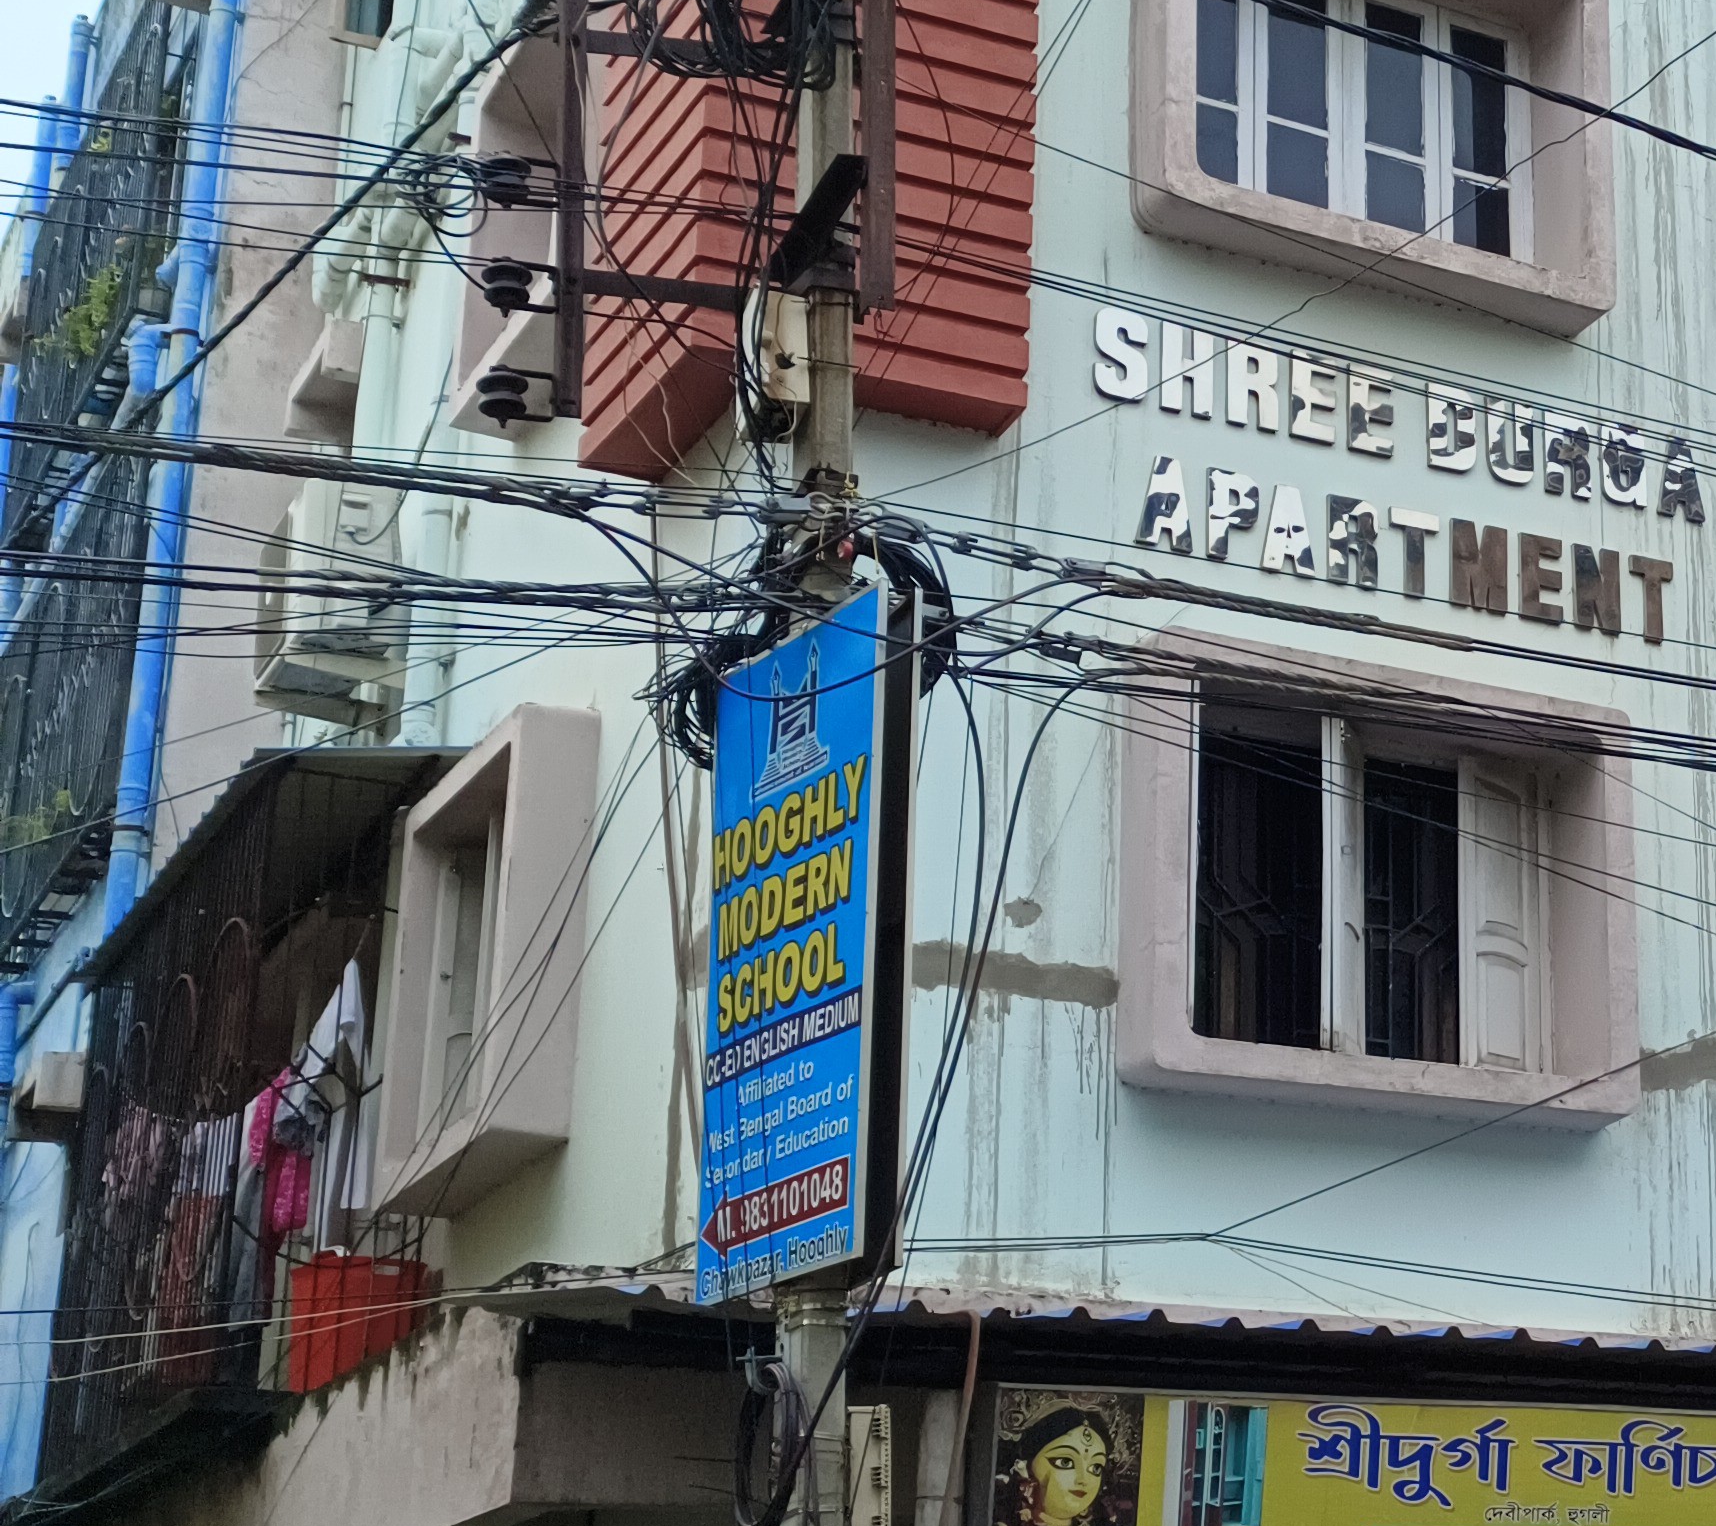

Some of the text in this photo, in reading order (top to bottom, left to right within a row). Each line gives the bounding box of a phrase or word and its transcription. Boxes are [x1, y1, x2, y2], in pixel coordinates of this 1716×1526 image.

[1093, 306, 1705, 523] SHREE DURGA
[1135, 454, 1673, 644] APARTMENT
[714, 753, 868, 890] HOOGHLY
[717, 838, 854, 961] MODERN
[717, 922, 845, 1033] SCHOOL
[743, 1018, 799, 1069] ENGLISH
[802, 992, 859, 1043] MEDIUM
[738, 1060, 814, 1107] Affiliated to
[787, 1082, 832, 1121] Board
[836, 1073, 855, 1101] of
[775, 1116, 849, 1159] Education
[740, 1165, 844, 1235] 9831101048
[787, 1220, 849, 1269] Hooghly
[1296, 1403, 1518, 1509] শ্রীদুর্গা
[1567, 1502, 1610, 1524] হুগলী
